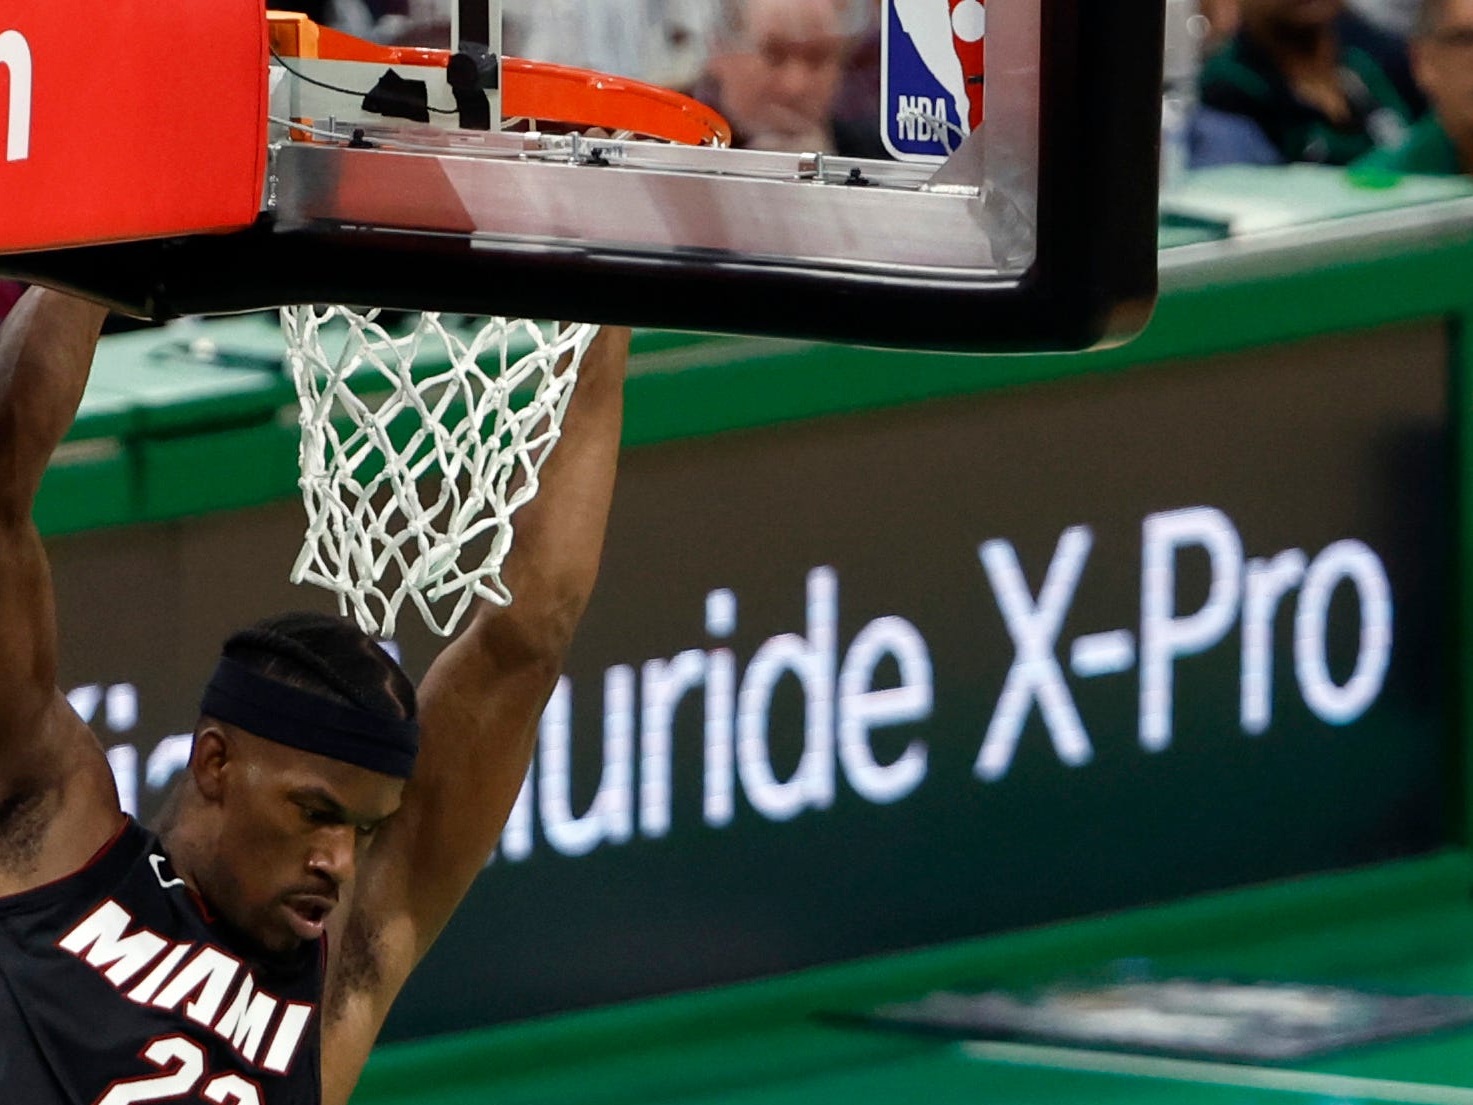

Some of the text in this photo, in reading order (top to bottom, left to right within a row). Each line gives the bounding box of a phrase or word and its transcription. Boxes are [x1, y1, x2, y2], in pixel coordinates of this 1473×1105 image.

[896, 94, 950, 142] NBA
[488, 564, 933, 863] uride
[973, 504, 1394, 783] X-Pro
[56, 897, 316, 1076] MIAMI
